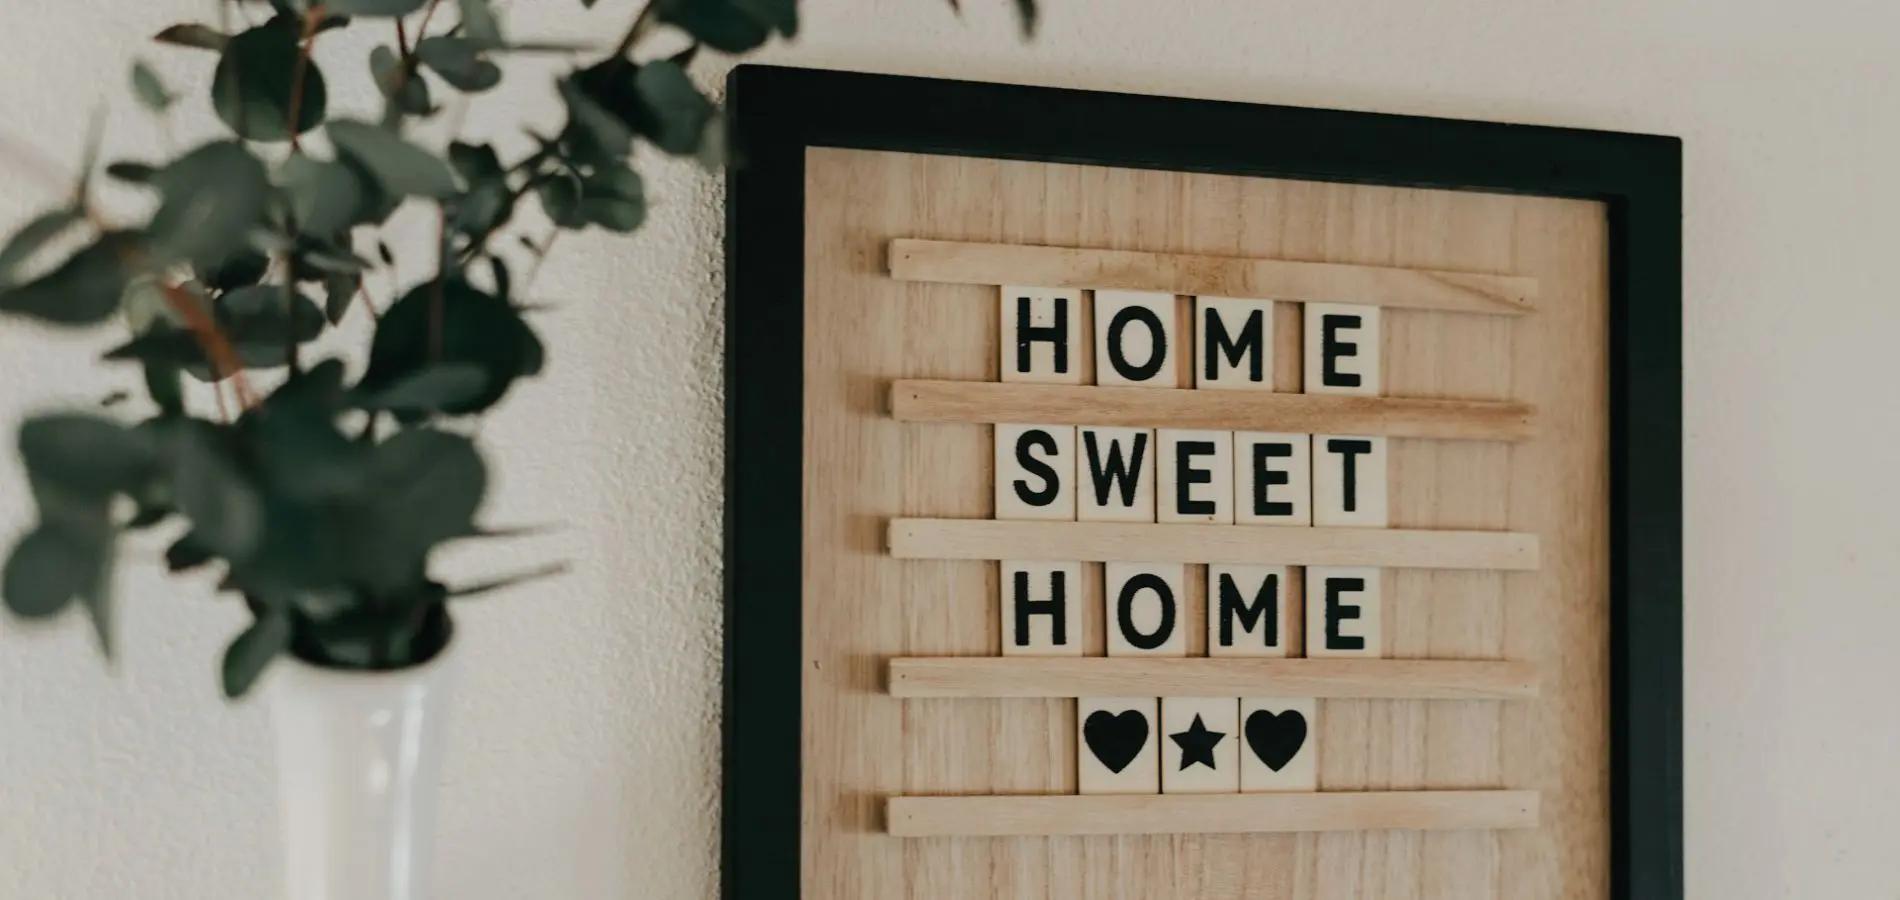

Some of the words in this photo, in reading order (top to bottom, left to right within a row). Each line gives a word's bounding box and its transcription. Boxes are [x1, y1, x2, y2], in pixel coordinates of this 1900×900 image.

[1015, 297, 1363, 388] HOME
[1013, 429, 1372, 516] SWEET
[1014, 570, 1365, 650] HOME
